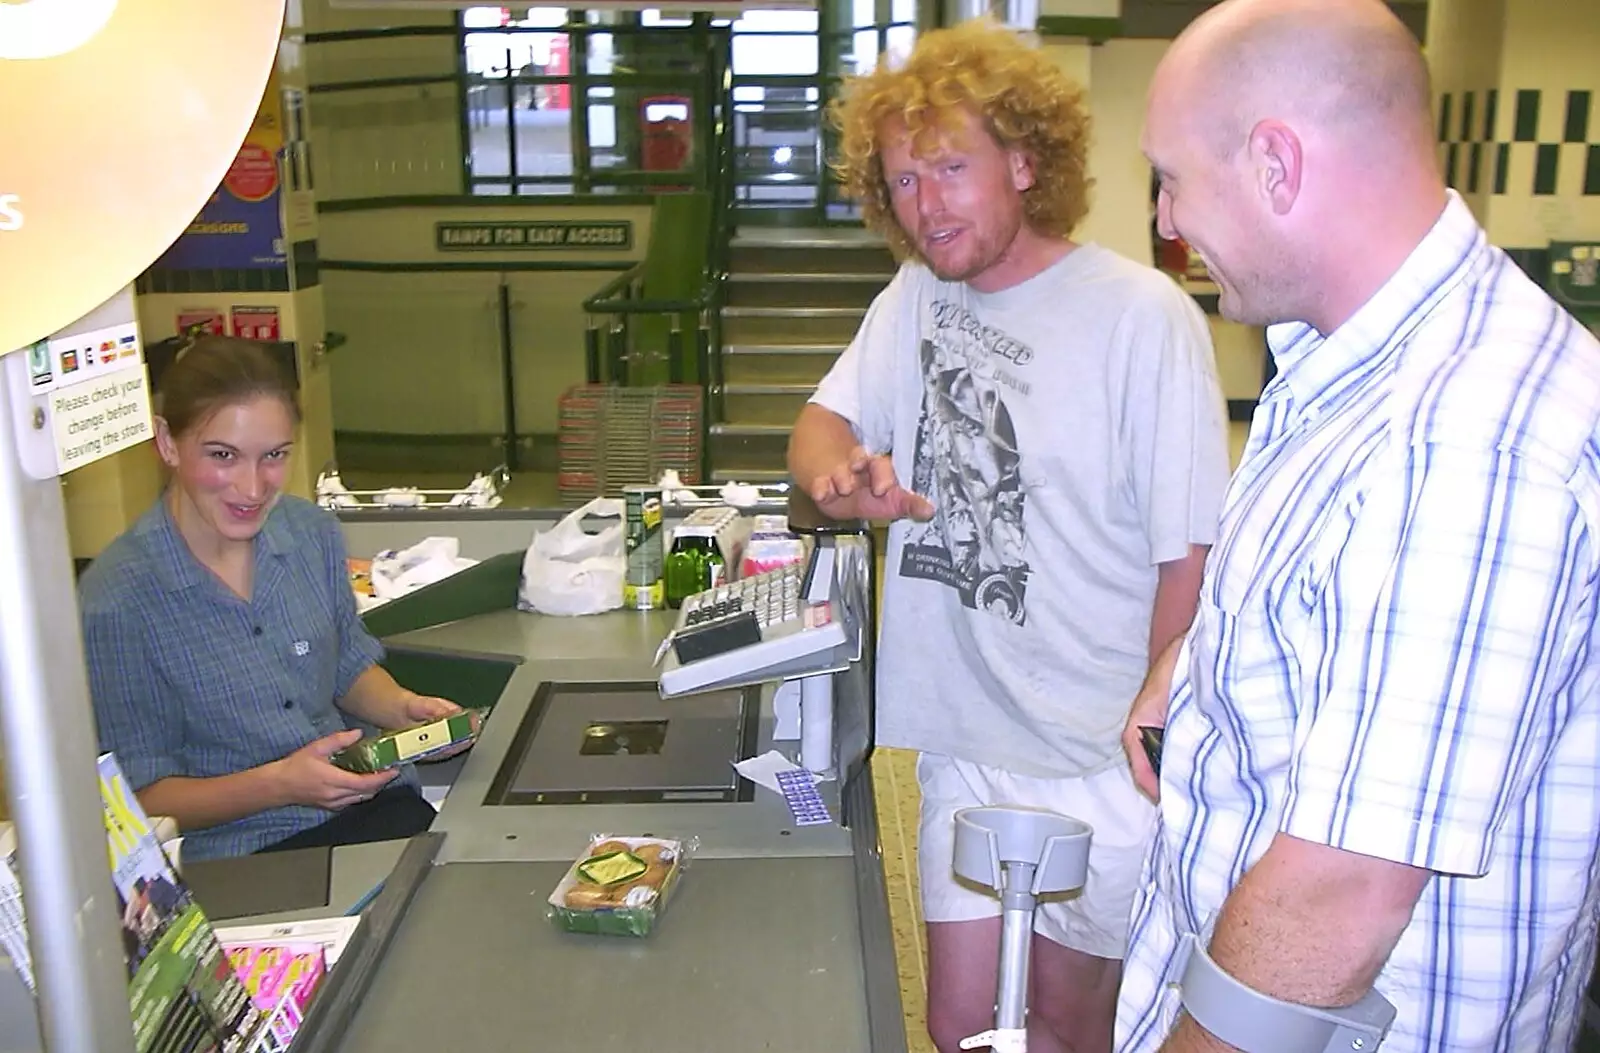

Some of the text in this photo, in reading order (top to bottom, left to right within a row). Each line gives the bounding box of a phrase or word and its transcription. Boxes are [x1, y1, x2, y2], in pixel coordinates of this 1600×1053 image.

[442, 226, 626, 245] RAMPS FOR EASY ACCESS
[55, 378, 142, 413] Please check your
[68, 401, 139, 435] change before
[62, 438, 102, 461] leaving
[103, 430, 120, 446] the
